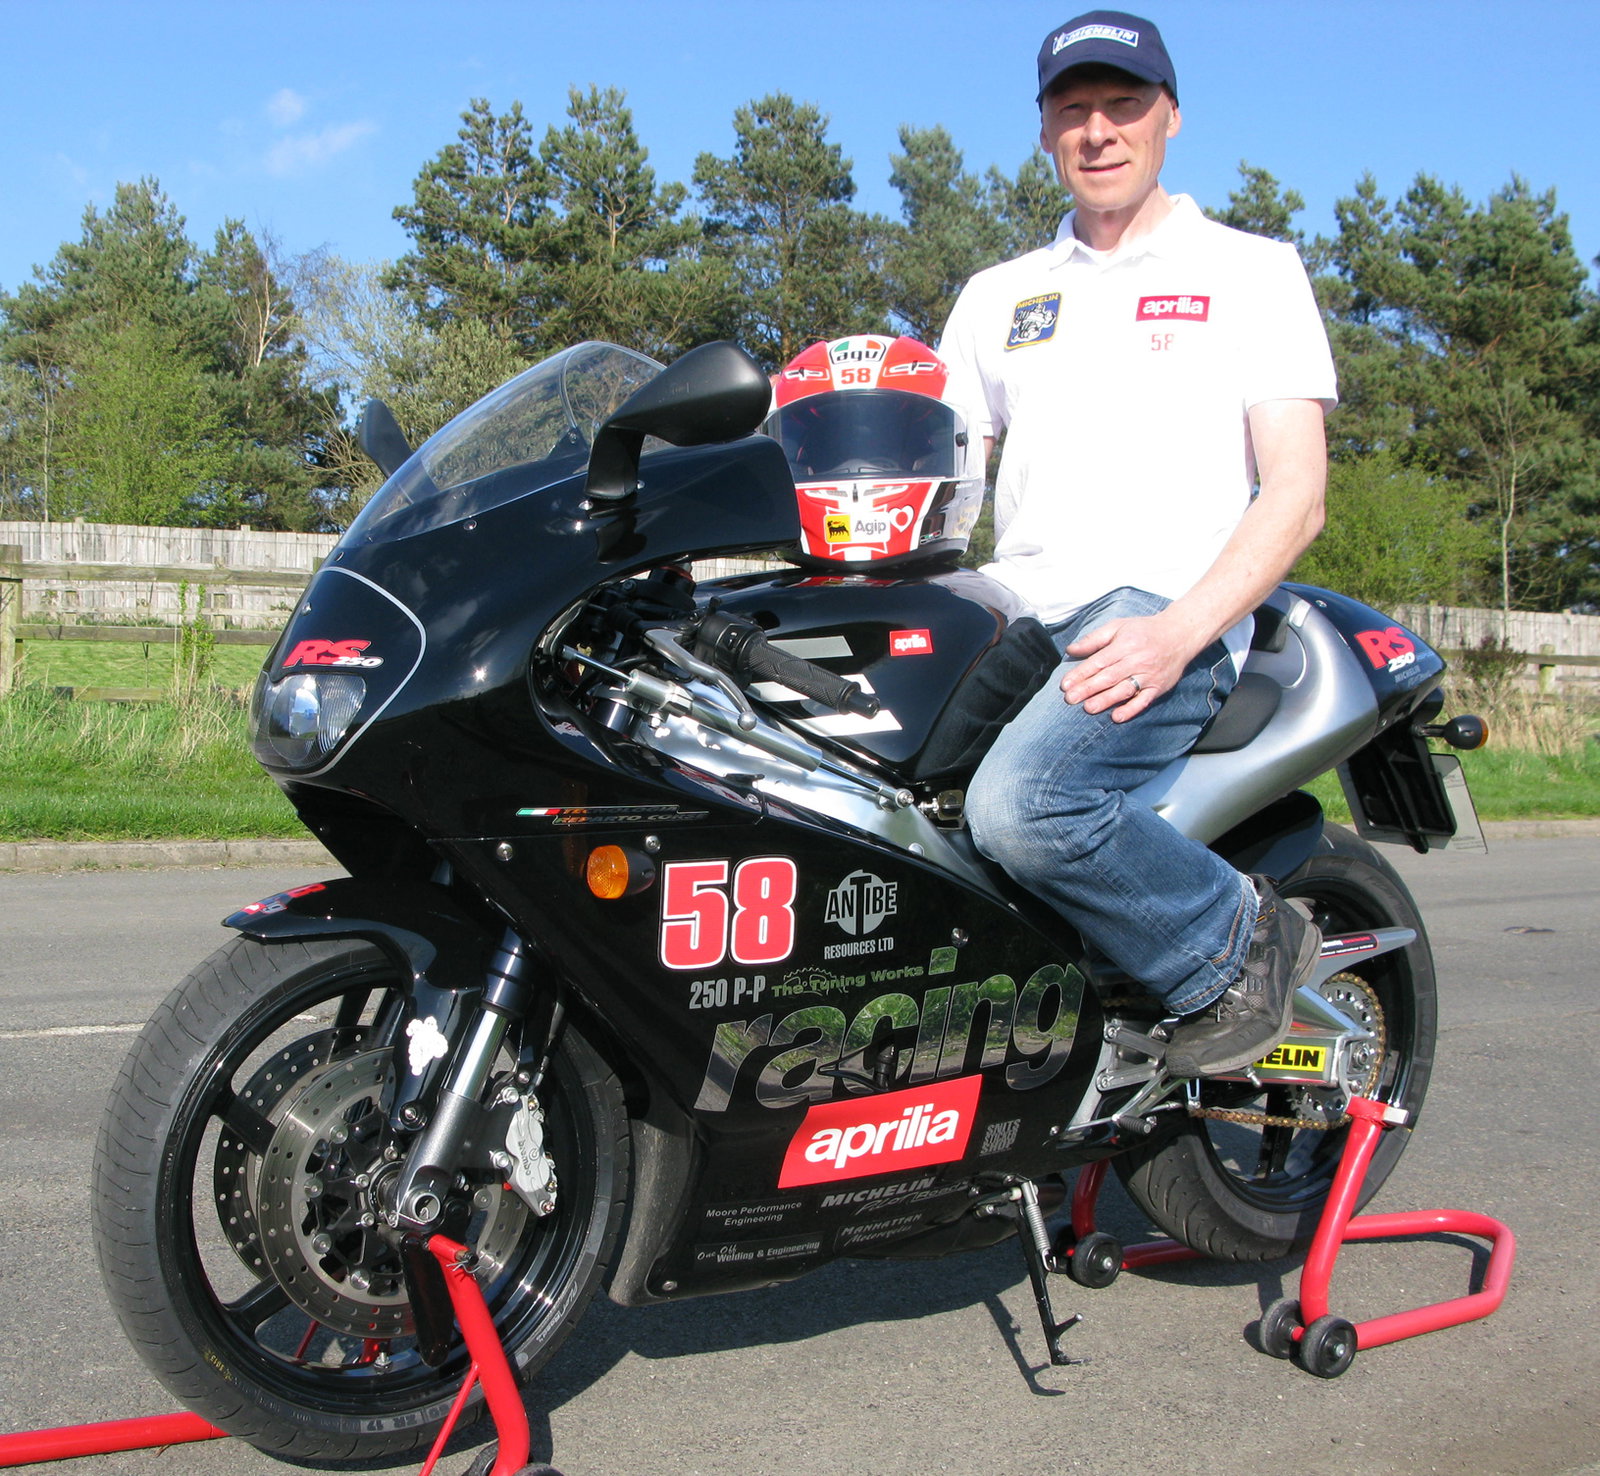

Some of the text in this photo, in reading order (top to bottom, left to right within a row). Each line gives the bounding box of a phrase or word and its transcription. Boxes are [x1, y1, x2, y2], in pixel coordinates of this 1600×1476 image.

[1016, 293, 1059, 309] MICHELIN
[1143, 296, 1204, 317] aprilia
[1151, 333, 1175, 351] 58
[841, 367, 871, 385] 58
[854, 518, 887, 536] Agip
[282, 639, 384, 669] RS 250
[894, 634, 927, 652] aprilia
[1354, 626, 1415, 670] RS
[1388, 652, 1416, 673] 250
[660, 855, 798, 970] 58
[824, 875, 898, 935] ANTIBE
[824, 937, 895, 960] RESOURCES LTD
[689, 975, 767, 1010] 250 P-P
[771, 965, 924, 998] The Tuning Works
[694, 947, 1086, 1112] racing
[804, 1103, 960, 1169] aprilia
[821, 1176, 936, 1208] MICHELIN
[706, 1201, 802, 1218] Moore Performance
[724, 1213, 784, 1227] Engineering
[717, 1251, 754, 1263] Welding
[757, 1249, 764, 1258] &
[767, 1241, 821, 1257] Engineering
